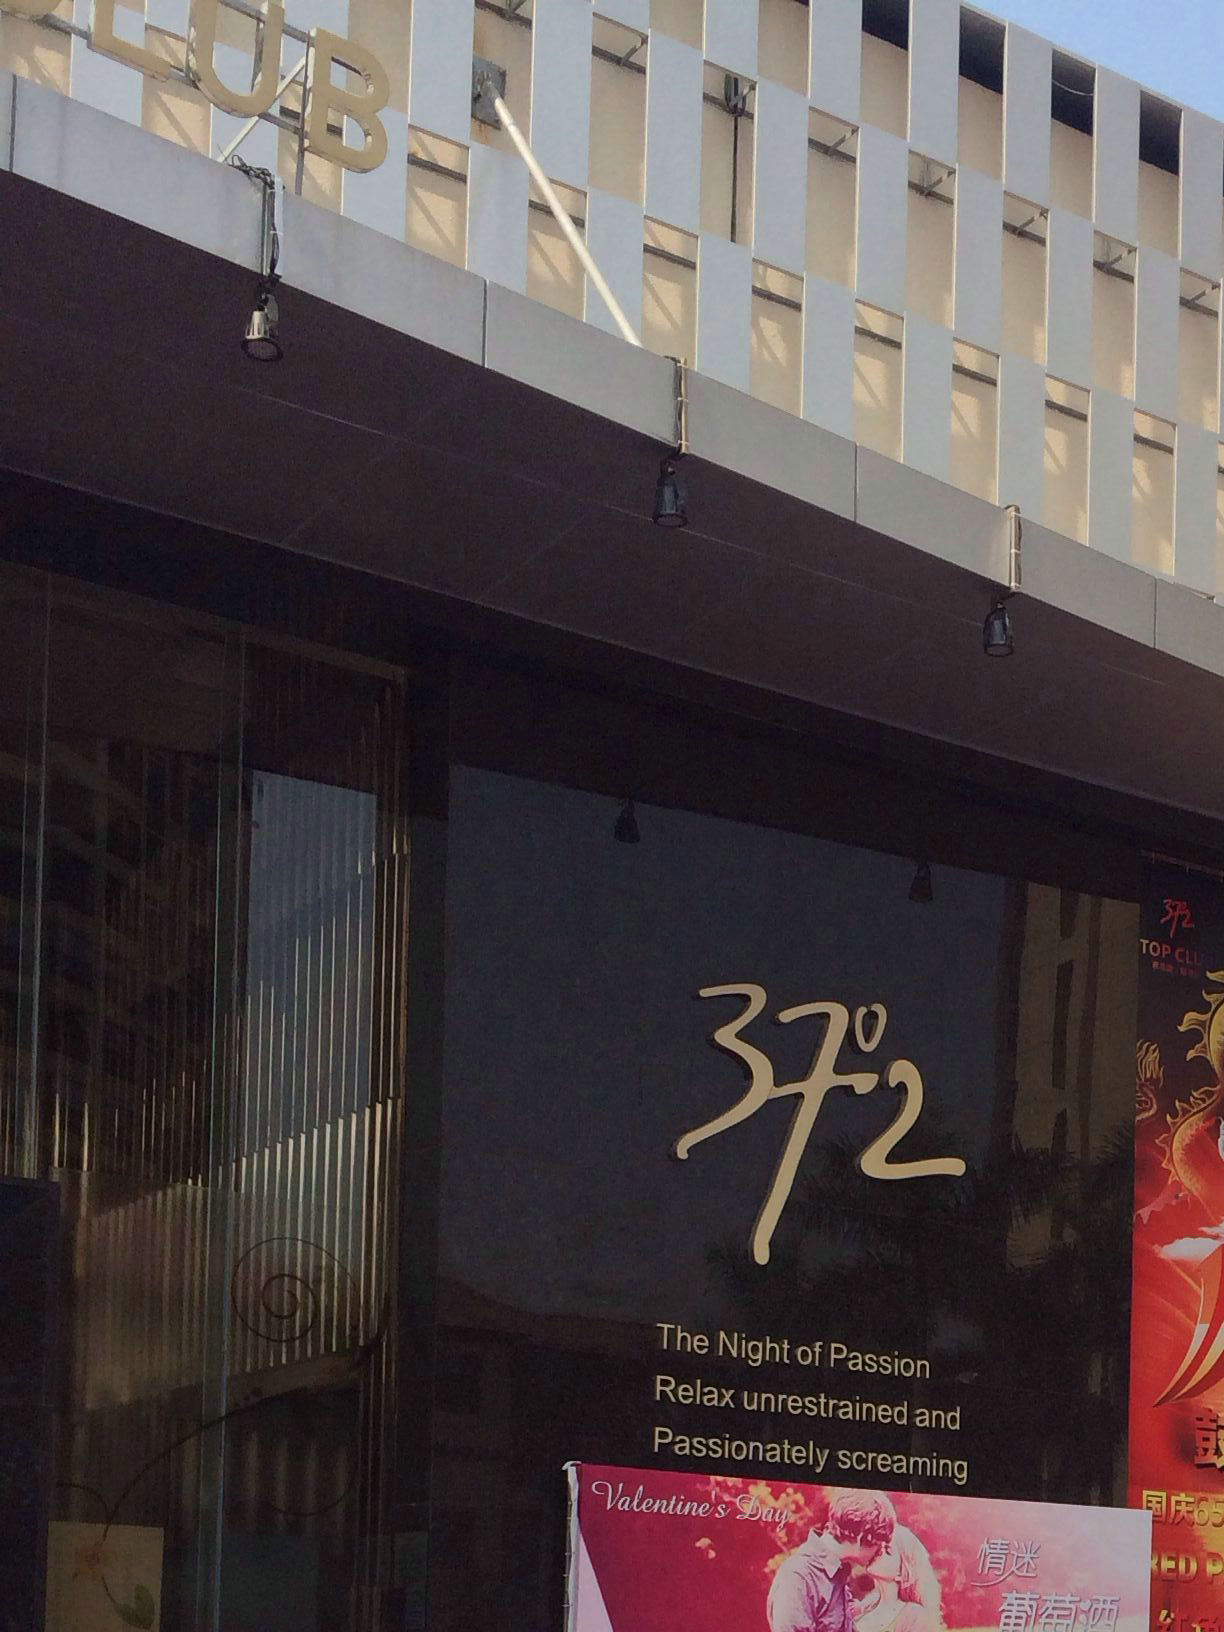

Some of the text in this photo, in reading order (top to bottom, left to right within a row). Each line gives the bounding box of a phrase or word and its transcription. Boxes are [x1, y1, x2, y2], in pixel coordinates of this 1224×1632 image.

[0, 0, 391, 174] LUB
[1140, 939, 1171, 959] TOP
[657, 1322, 931, 1379] The Night of Passion
[655, 1374, 961, 1430] Relax unrestrained and
[653, 1426, 969, 1486] Passionately screaming
[591, 1481, 791, 1530] Valentine's Day
[973, 1537, 1041, 1584] 情迷
